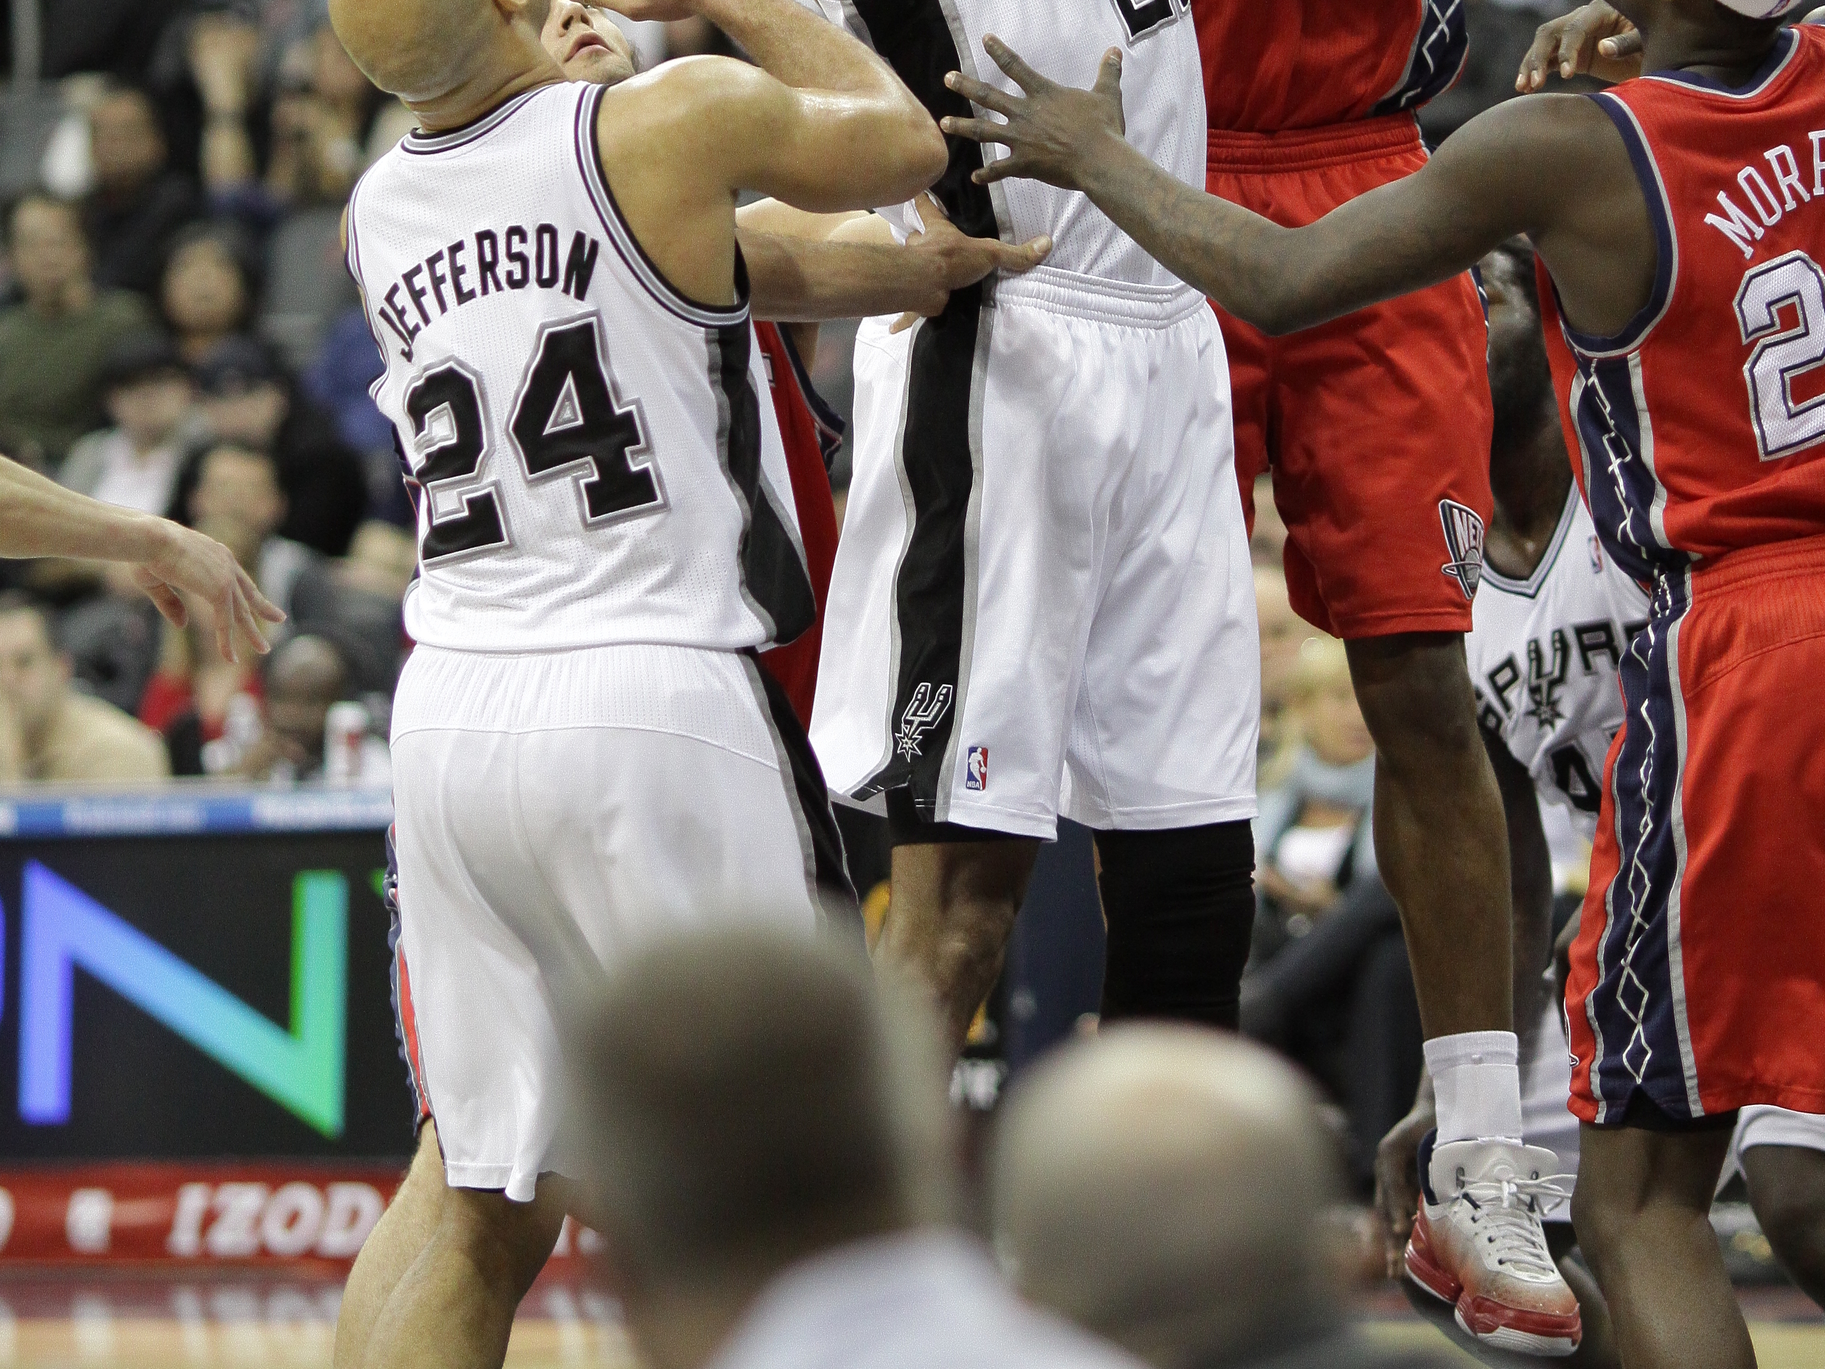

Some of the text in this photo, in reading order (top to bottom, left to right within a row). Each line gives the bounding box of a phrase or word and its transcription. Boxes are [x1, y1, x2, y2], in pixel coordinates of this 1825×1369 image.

[379, 223, 598, 363] JEFFERSON
[404, 309, 671, 571] 24
[167, 1181, 386, 1258] IZOD
